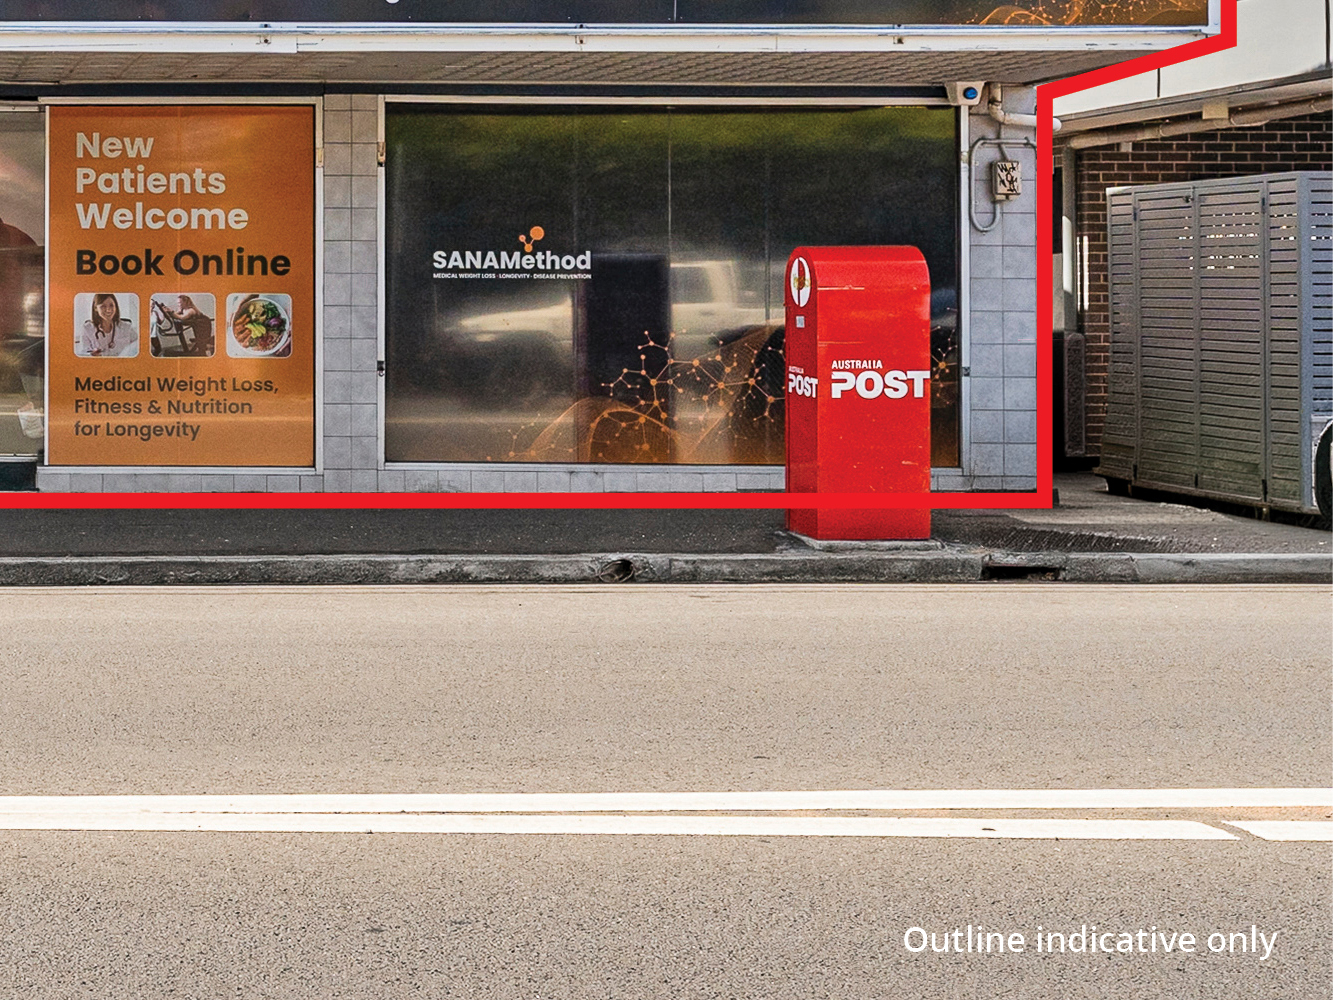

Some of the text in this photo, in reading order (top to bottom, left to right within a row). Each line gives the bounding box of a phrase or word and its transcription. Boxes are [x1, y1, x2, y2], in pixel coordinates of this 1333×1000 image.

[76, 132, 154, 158] New
[76, 165, 226, 194] Patients
[76, 202, 248, 229] Welcome
[76, 247, 291, 276] Book Online
[433, 251, 591, 270] SANAMethod
[831, 360, 883, 369] AUSTRALIA
[75, 376, 279, 395] Medical Weight Loss,
[788, 374, 818, 398] POST
[831, 371, 930, 399] POST
[74, 398, 252, 414] Fitness & Nutrition
[74, 421, 201, 441] for Longevity
